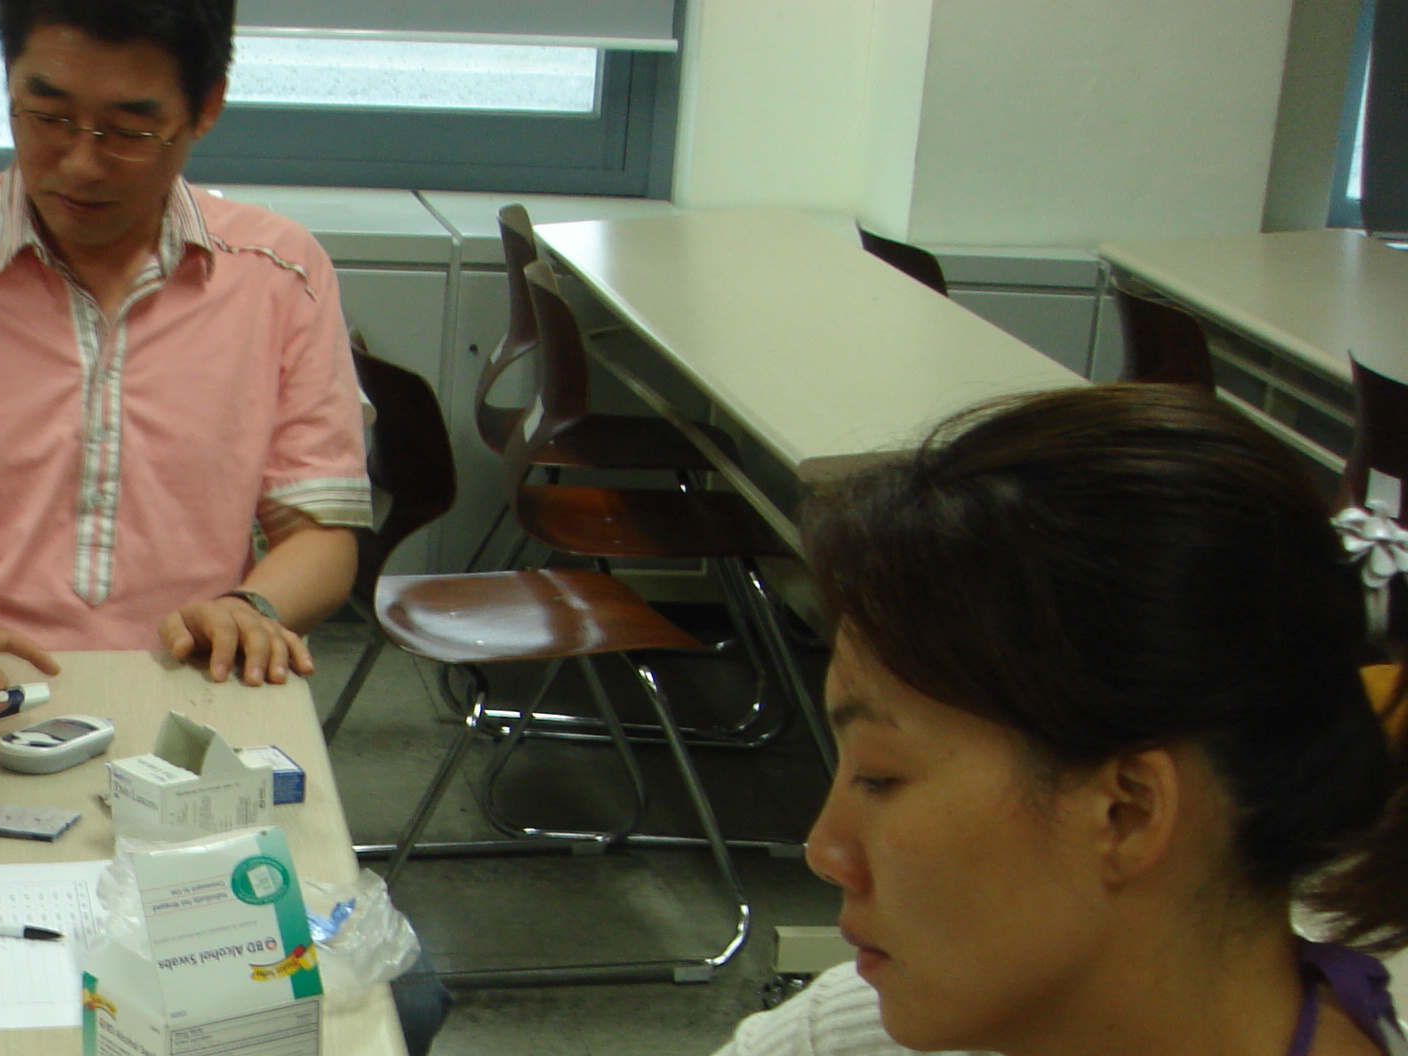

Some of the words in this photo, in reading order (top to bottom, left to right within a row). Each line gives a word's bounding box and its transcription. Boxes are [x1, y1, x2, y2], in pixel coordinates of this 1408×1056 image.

[200, 943, 244, 964] Alcohol
[245, 940, 265, 955] BD
[157, 953, 197, 972] Swabs
